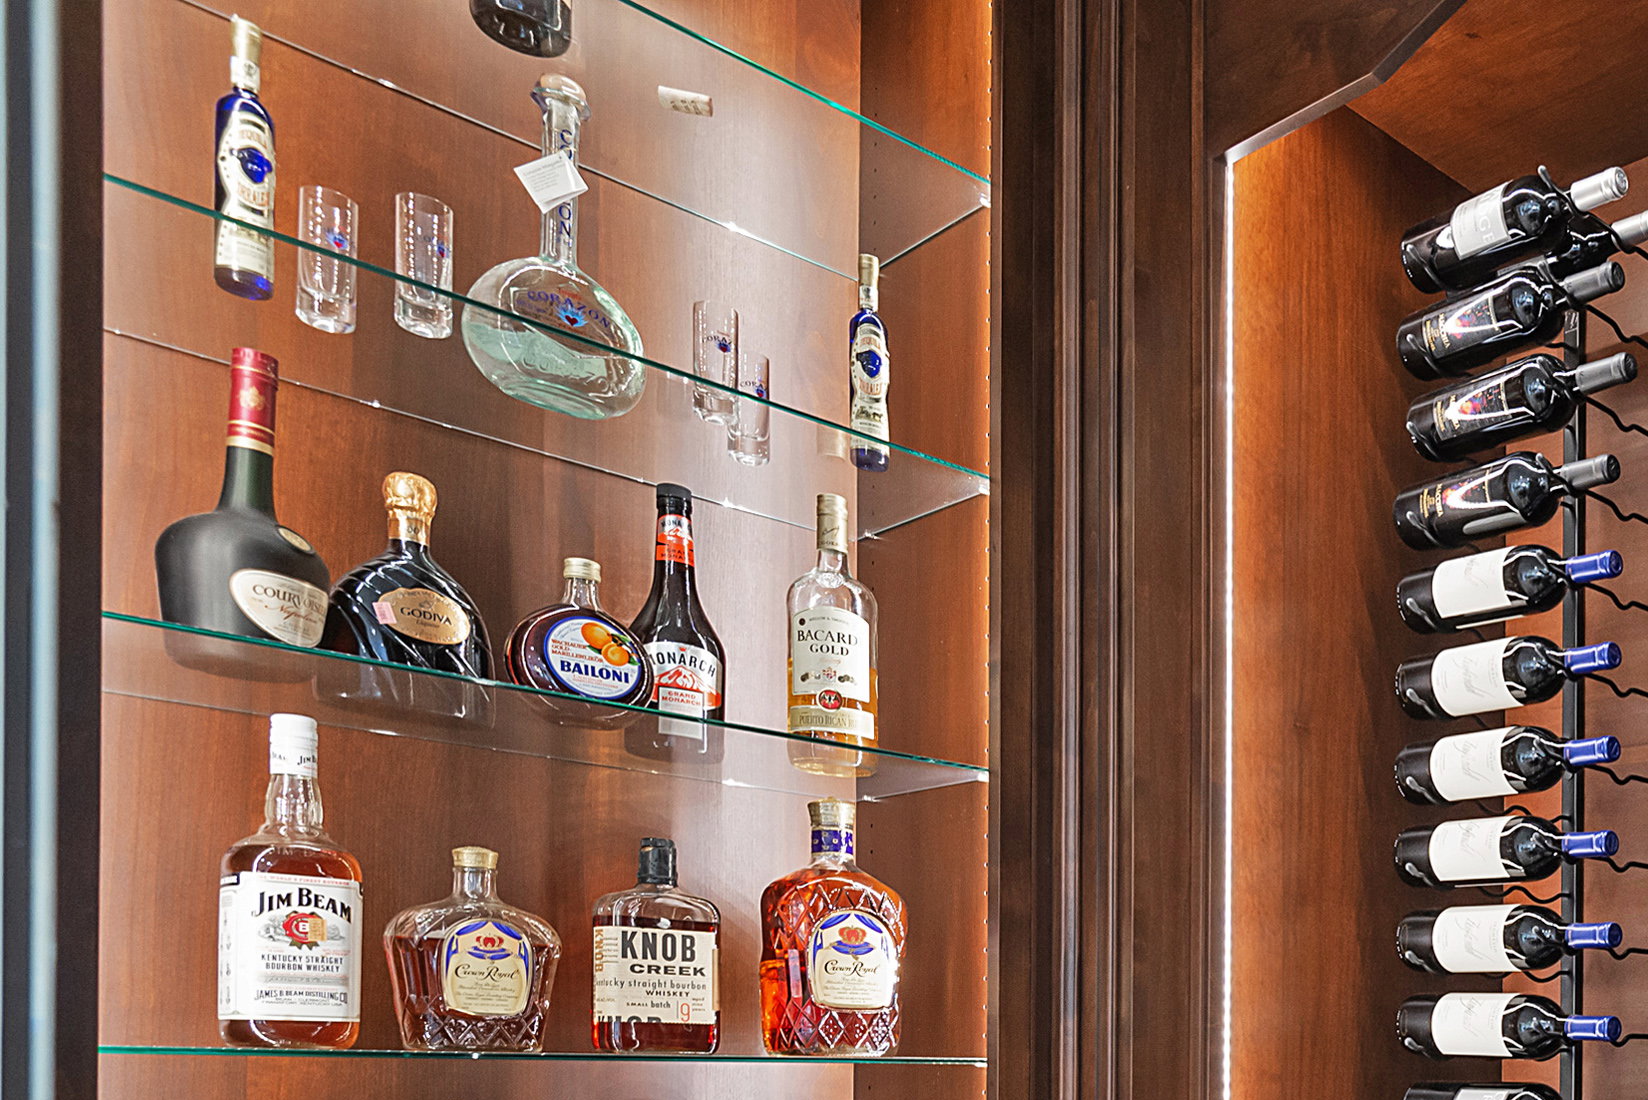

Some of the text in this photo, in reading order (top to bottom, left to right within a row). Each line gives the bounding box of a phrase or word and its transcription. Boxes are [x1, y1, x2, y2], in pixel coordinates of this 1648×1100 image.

[400, 607, 452, 626] GODIVA
[809, 644, 849, 656] GOLD
[560, 660, 631, 684] BAILONI
[661, 696, 702, 706] MONARCH
[667, 691, 697, 700] GRAND
[252, 886, 352, 924] JIM BEAM
[595, 929, 604, 973] KNOB
[621, 930, 696, 963] KNOB
[261, 953, 344, 965] KENTUCKY STRAIGHT
[265, 962, 340, 973] BOURBON WHISKEY
[455, 963, 516, 982] Crown Royal
[629, 963, 706, 977] CREEK
[824, 960, 880, 977] Crown Royal
[628, 978, 706, 991] straight bourbon
[254, 989, 278, 1001] JAMES
[305, 991, 339, 1001] DISTILLING
[645, 990, 690, 998] WHISKEY
[650, 1000, 671, 1009] batch
[680, 1002, 690, 1023] 9
